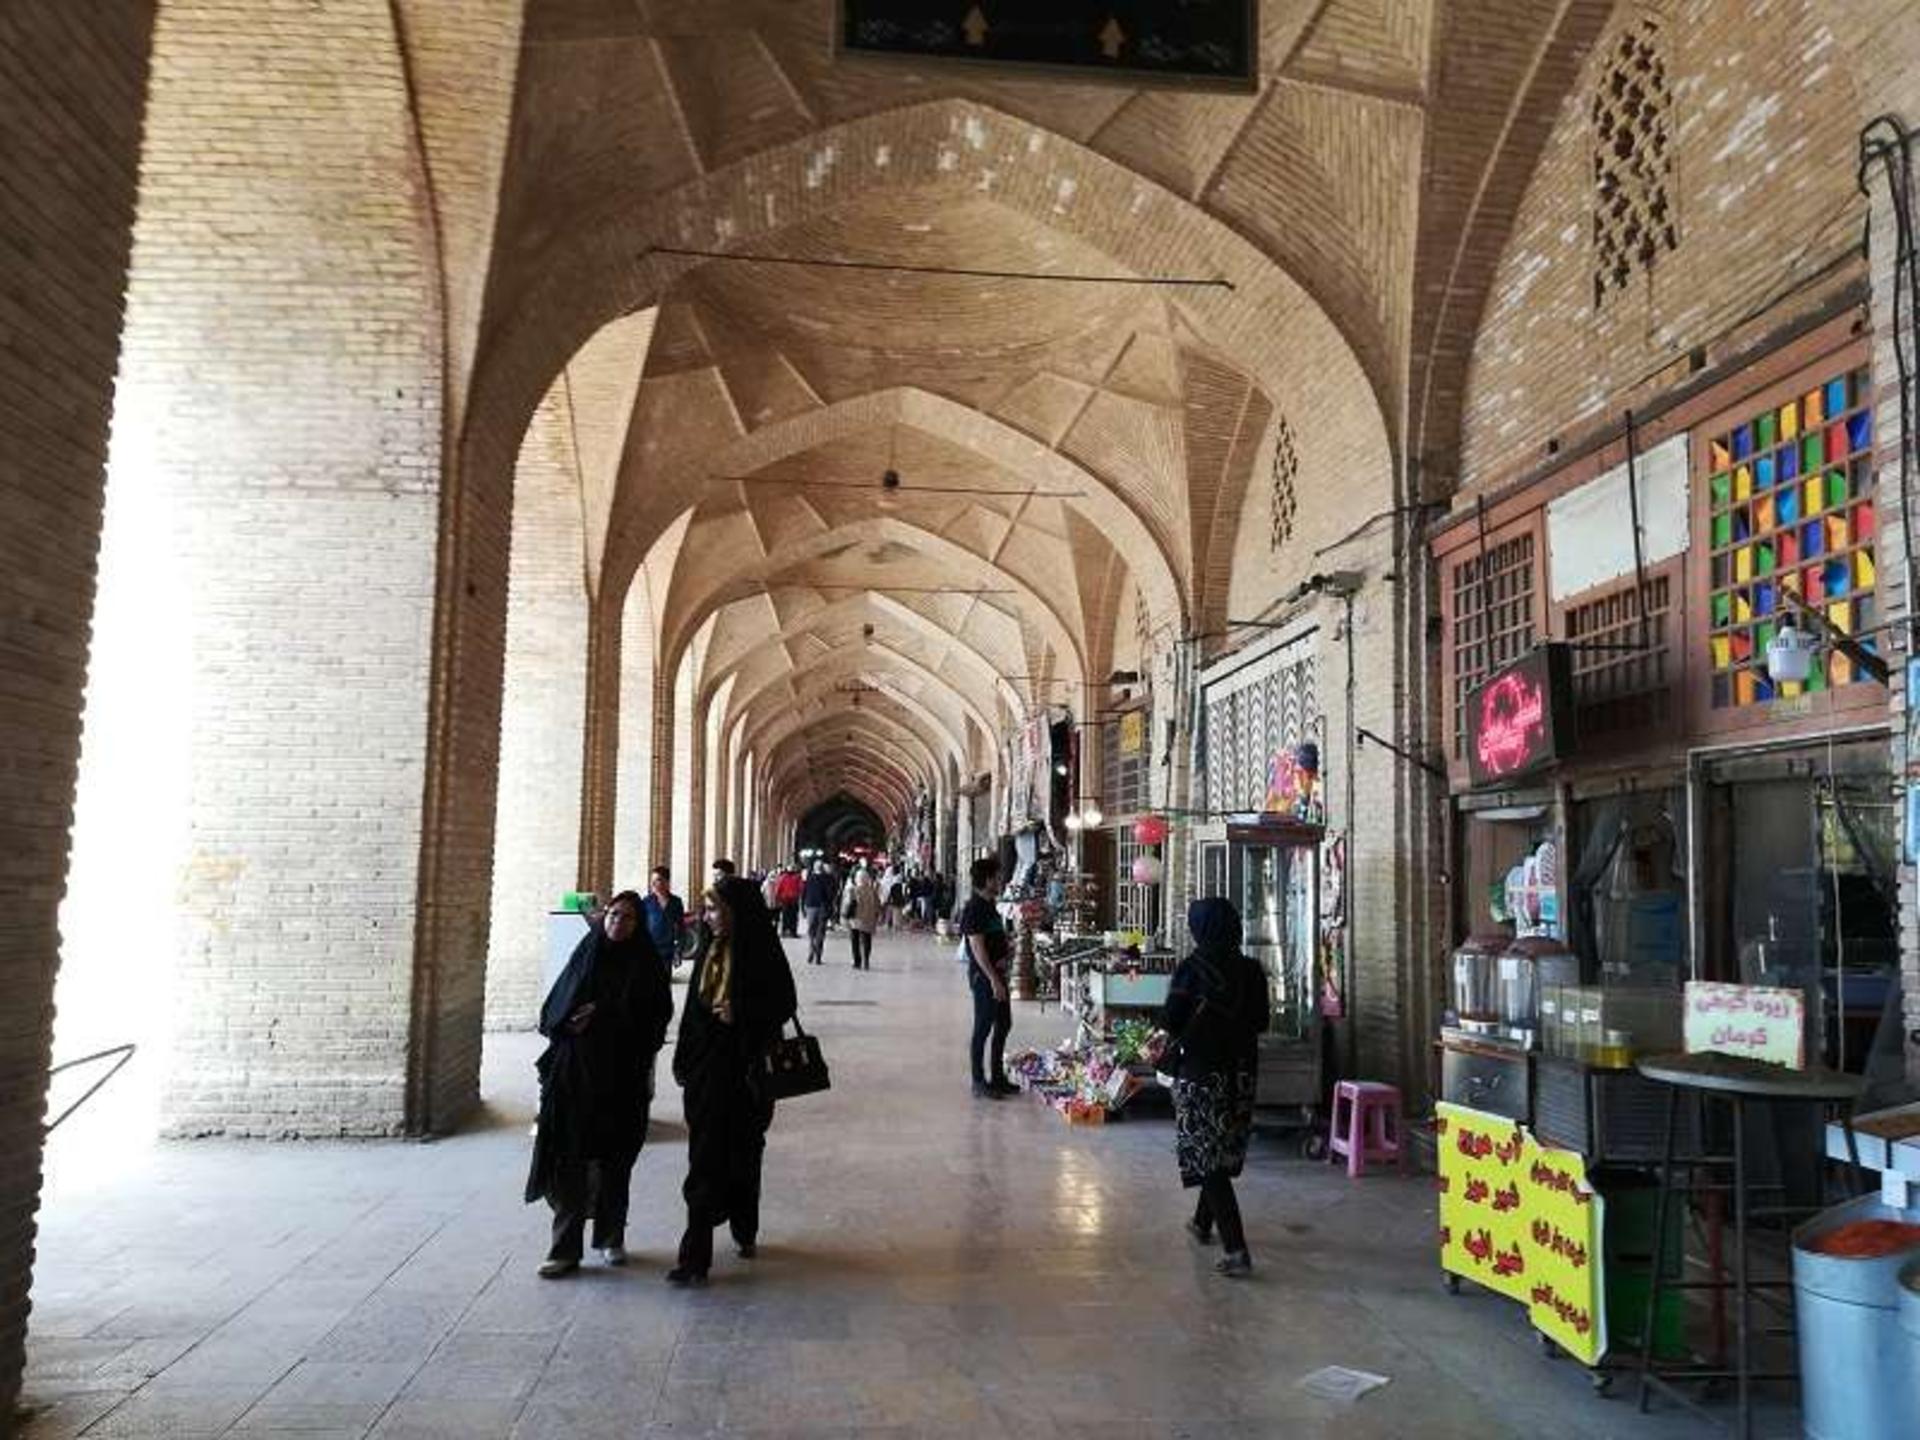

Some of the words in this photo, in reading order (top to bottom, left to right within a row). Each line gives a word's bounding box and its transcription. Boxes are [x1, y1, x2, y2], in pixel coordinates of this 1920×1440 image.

[1496, 1131, 1521, 1166] آب
[1492, 1179, 1520, 1212] شیر
[1492, 1240, 1524, 1276] شیر
